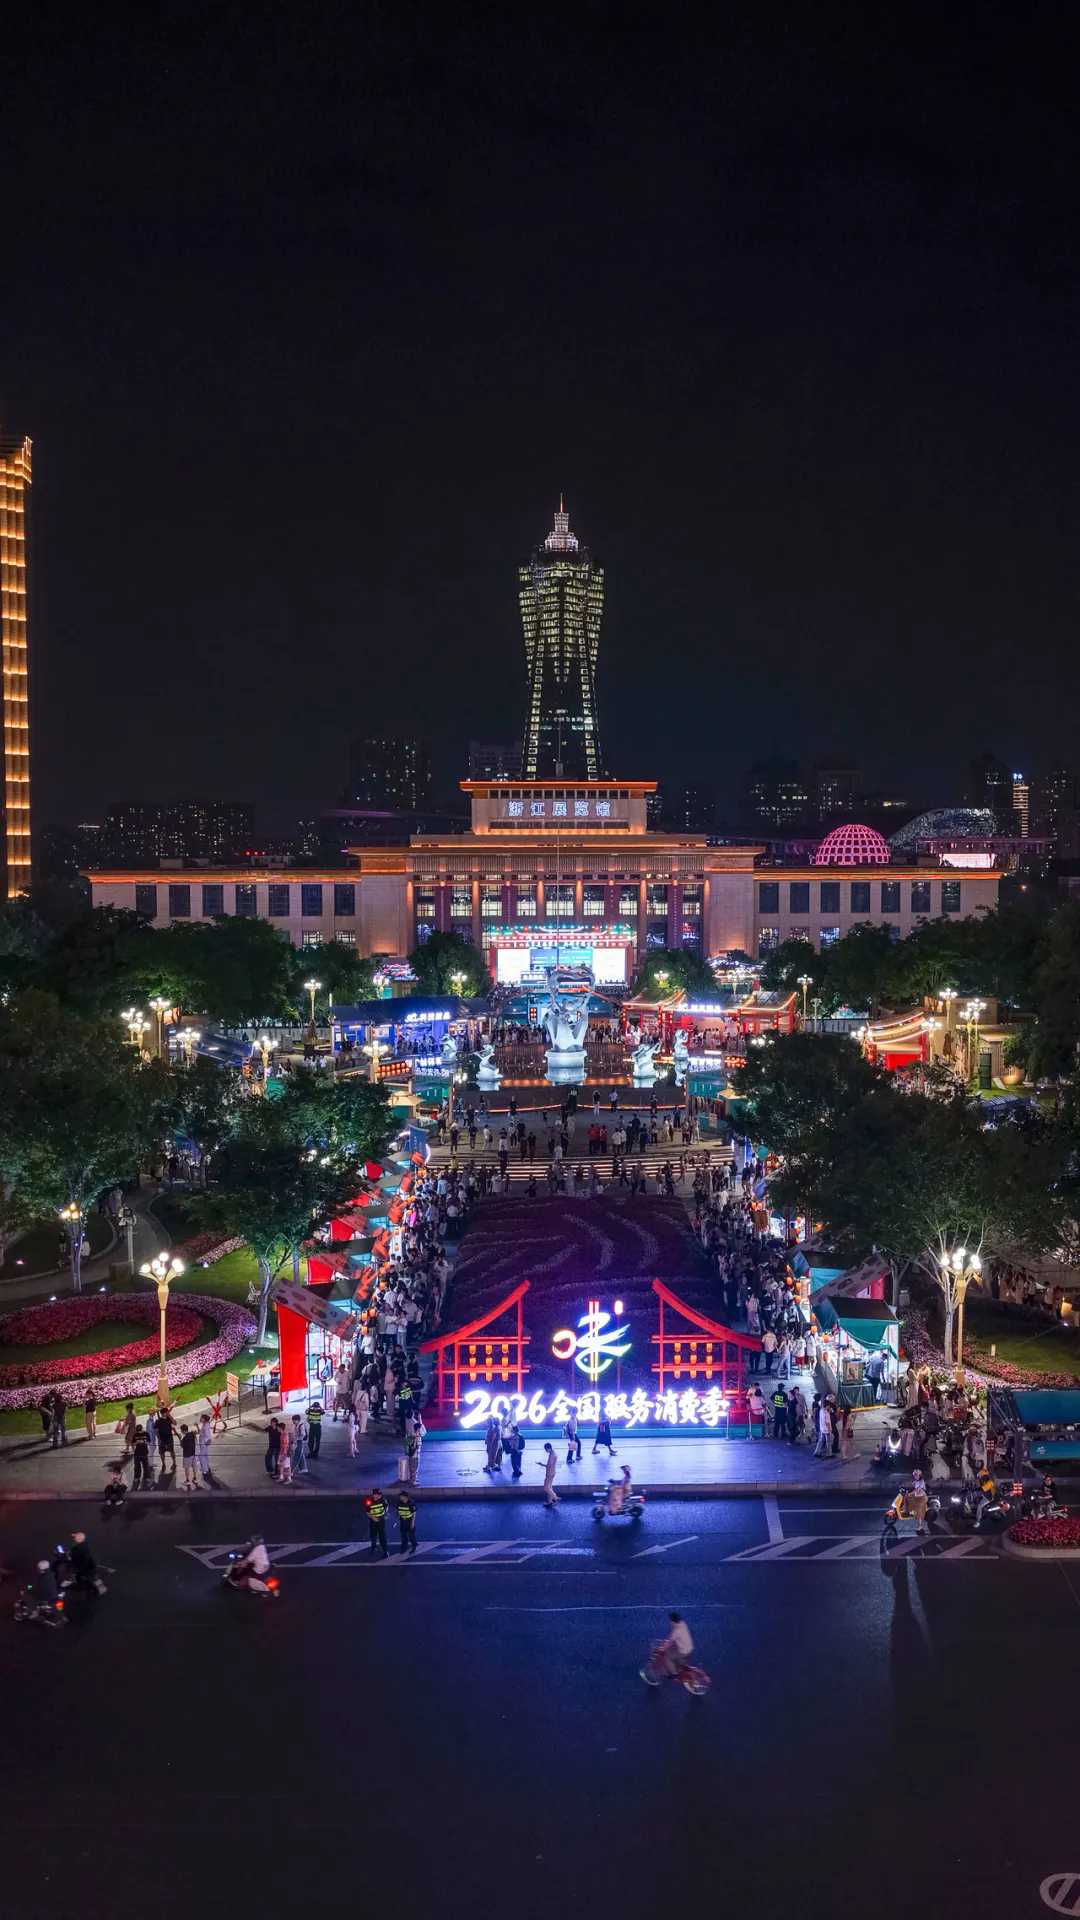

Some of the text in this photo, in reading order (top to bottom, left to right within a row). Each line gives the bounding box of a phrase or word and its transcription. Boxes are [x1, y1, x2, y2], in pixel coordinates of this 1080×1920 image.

[508, 801, 611, 817] 浙江展览馆
